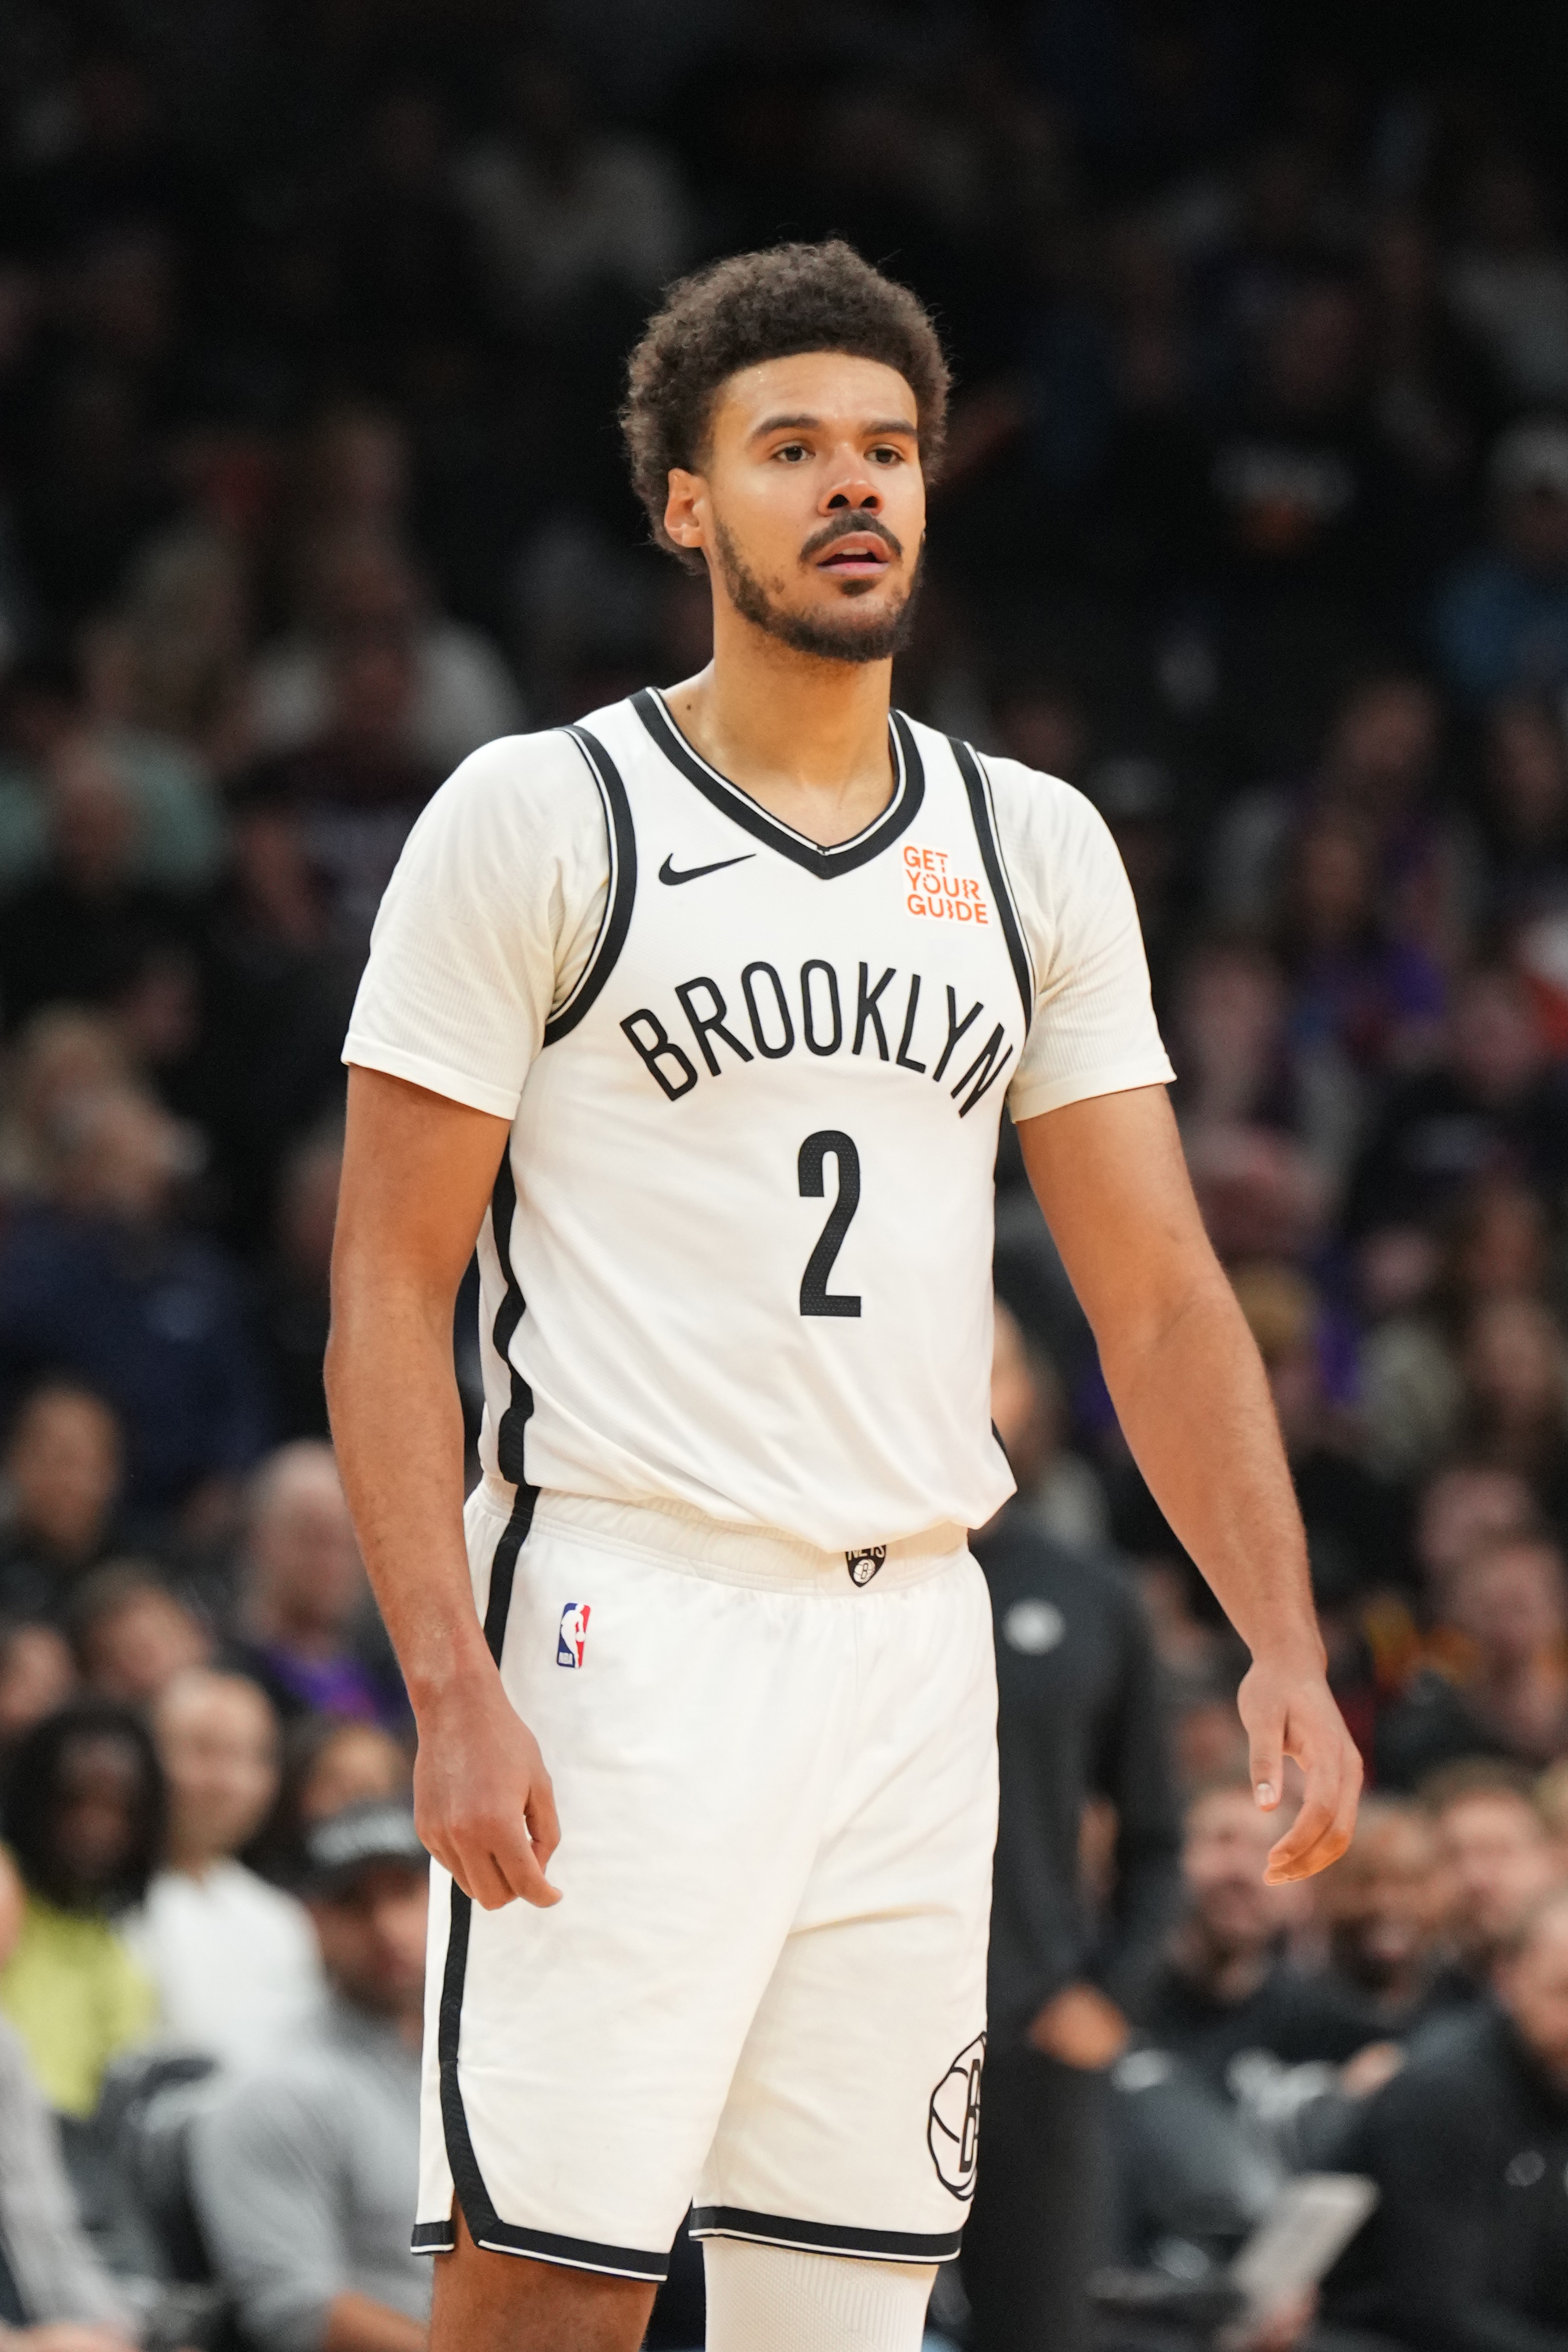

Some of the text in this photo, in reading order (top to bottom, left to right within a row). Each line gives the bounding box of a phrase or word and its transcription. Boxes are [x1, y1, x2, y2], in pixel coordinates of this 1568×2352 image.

[903, 845, 948, 873] GET
[906, 869, 981, 900] YOUR
[907, 894, 989, 925] GUIDE
[620, 959, 1013, 1118] BROOKLYN
[798, 1130, 861, 1317] 2
